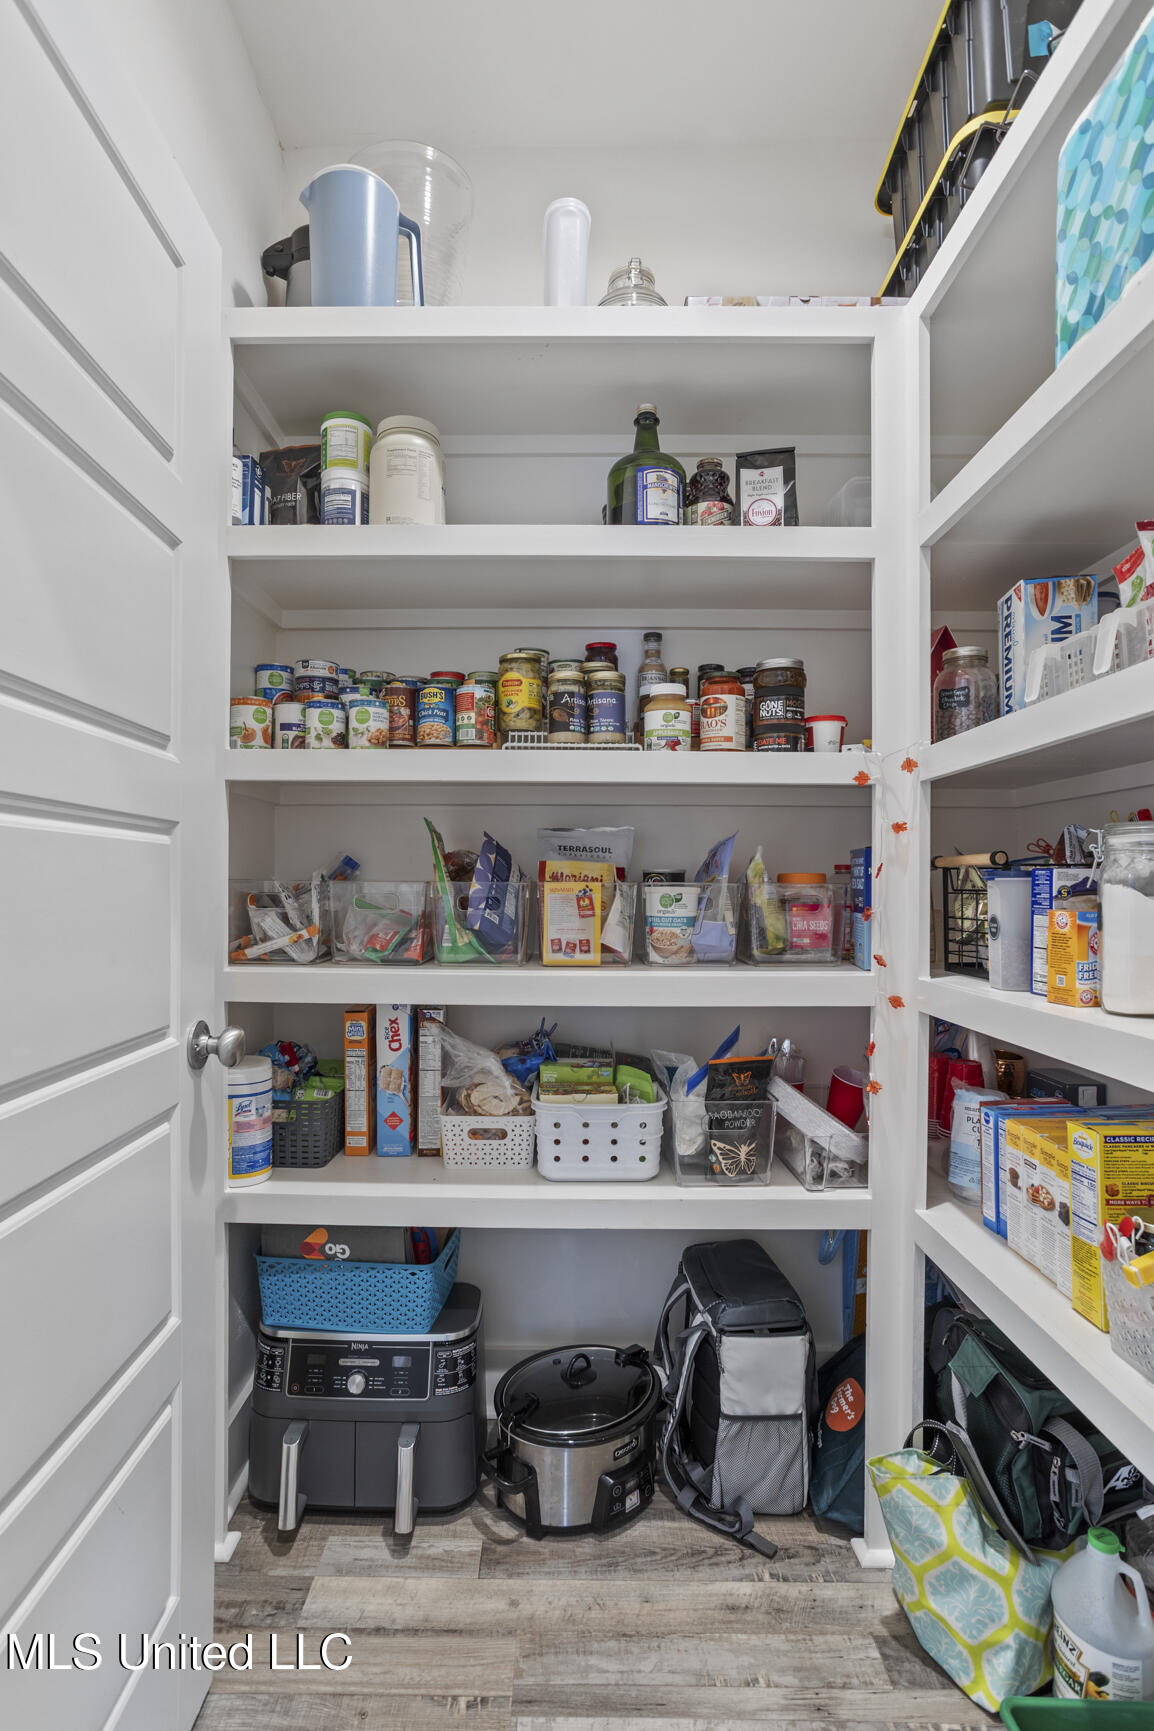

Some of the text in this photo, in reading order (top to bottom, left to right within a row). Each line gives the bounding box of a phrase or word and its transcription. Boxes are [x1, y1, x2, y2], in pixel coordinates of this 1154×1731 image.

[745, 478, 779, 486] BREAKFAST
[1003, 593, 1015, 716] PREMIUM
[420, 691, 444, 700] BUSH'S
[760, 700, 784, 710] GONE
[557, 844, 614, 855] TERRASOUL
[809, 920, 828, 931] SEEDS
[388, 1016, 403, 1052] Chex
[724, 1119, 756, 1129] POWDER
[350, 1342, 369, 1352] NINJA
[843, 1383, 854, 1402] The
